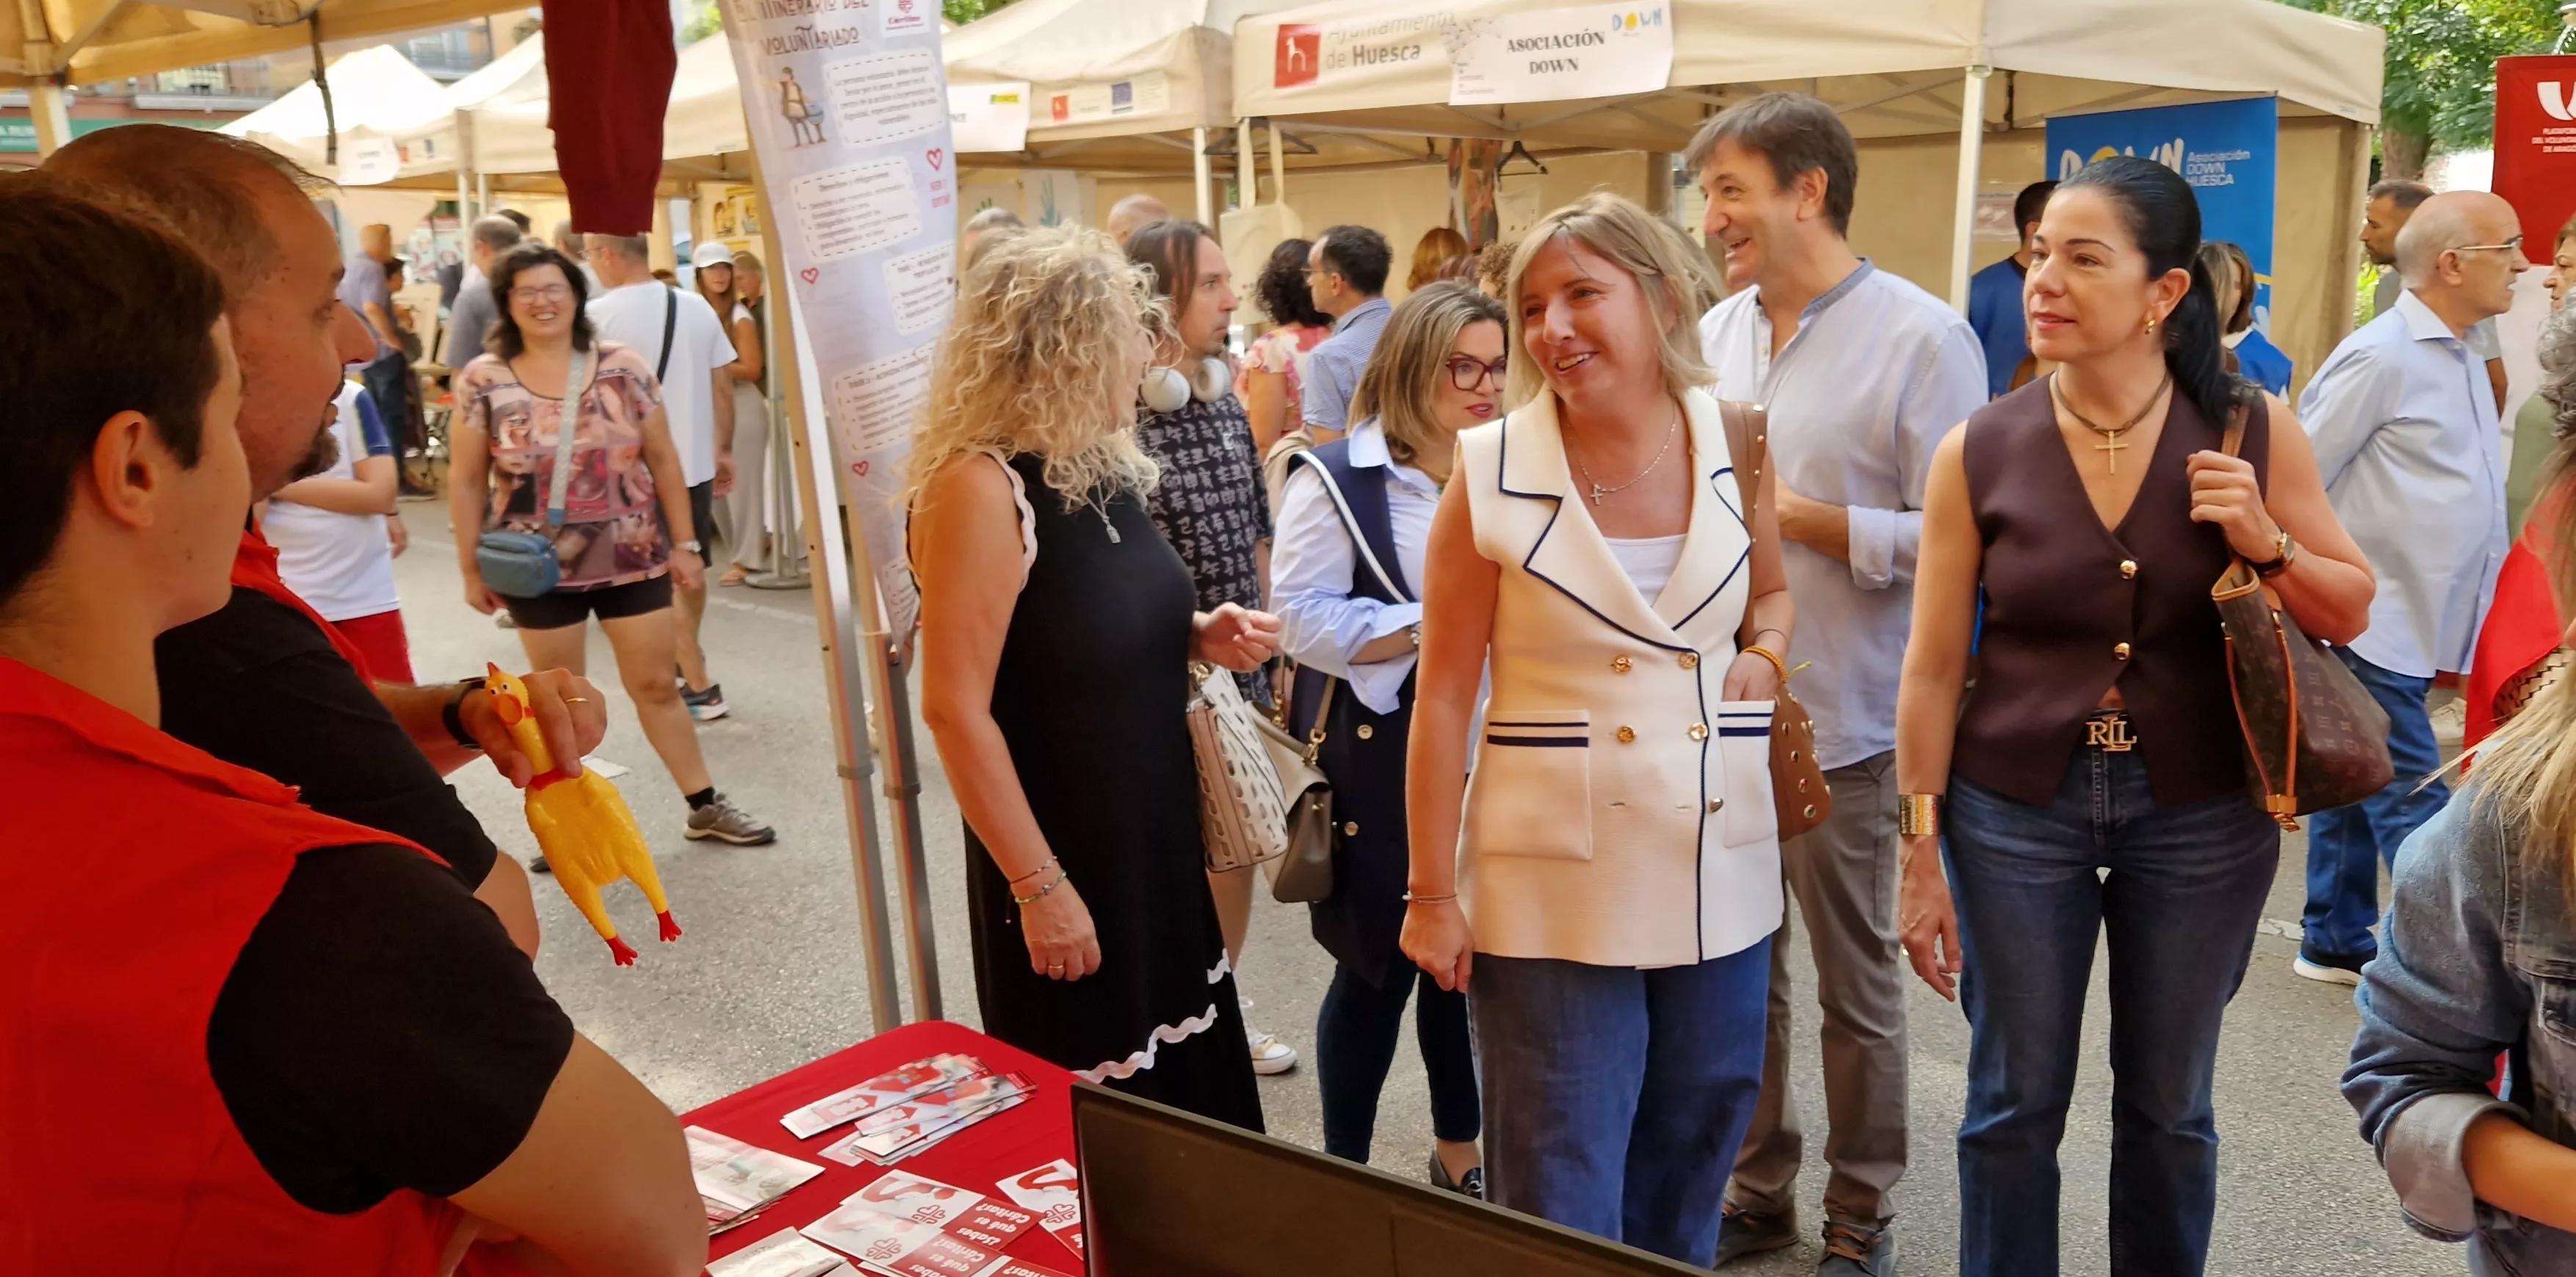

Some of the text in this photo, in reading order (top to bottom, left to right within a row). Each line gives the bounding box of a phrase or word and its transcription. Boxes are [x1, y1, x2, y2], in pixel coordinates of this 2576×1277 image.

[760, 24, 860, 55] VOLUNTARIADO
[1507, 28, 1605, 53] ASOCIACIÓN
[1326, 44, 1421, 69] de Huesca
[1529, 58, 1579, 75] DOWN
[2187, 149, 2251, 162] Asociación
[2186, 162, 2226, 175] DOWN
[975, 1202, 1031, 1224] Cáritas?
[974, 1216, 1018, 1234] qué es
[932, 1237, 986, 1263] Cáritas?
[928, 1253, 972, 1273] qué es
